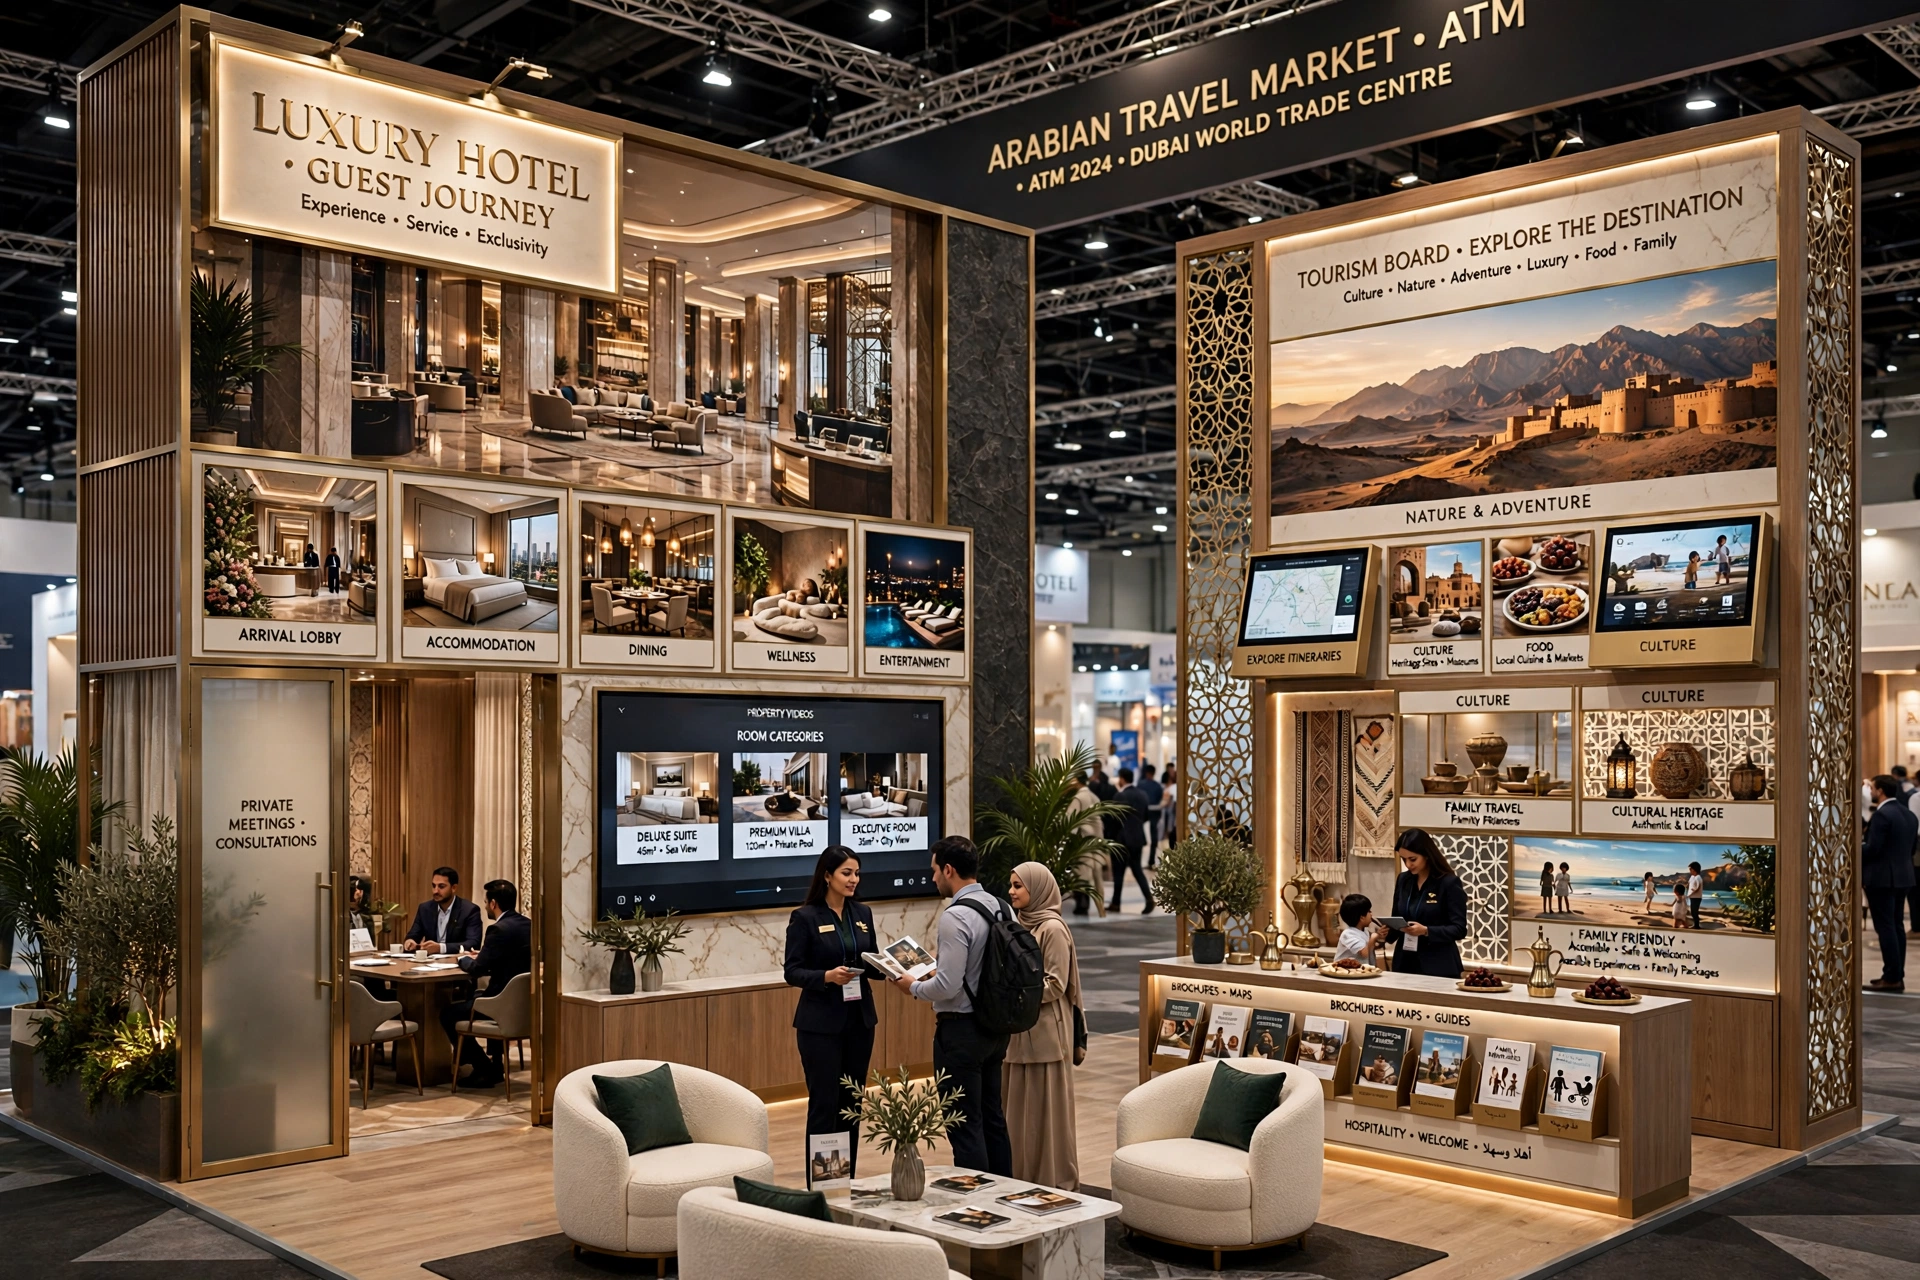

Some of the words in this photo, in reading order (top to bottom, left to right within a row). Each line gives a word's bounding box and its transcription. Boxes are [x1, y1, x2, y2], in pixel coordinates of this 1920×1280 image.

[988, 112, 1110, 173] ARABIAN
[1119, 78, 1238, 135] TRAVEL
[1251, 26, 1400, 100] MARKET
[1438, 0, 1525, 49] ATM
[1029, 167, 1064, 192] ATM
[1070, 154, 1112, 182] 2024
[1130, 133, 1189, 166] DUBAI
[1195, 113, 1271, 148] WORLD
[1277, 90, 1350, 126] TRADE
[1358, 62, 1452, 106] CENTRE
[252, 91, 439, 167] LUXURY
[457, 139, 590, 202] HOTEL
[307, 157, 411, 200] GUEST
[421, 181, 554, 229] JOURNEY
[301, 193, 386, 224] Experience
[406, 214, 459, 237] Service
[477, 228, 548, 259] Exclusivity
[1298, 257, 1378, 288] TOURISM
[1384, 244, 1449, 273] BOARD
[1470, 223, 1551, 257] EXPLORE
[1558, 215, 1596, 239] THE
[1603, 186, 1743, 232] DESTINATION
[1343, 288, 1383, 303] Culture
[1397, 278, 1436, 294] Nature
[1450, 264, 1511, 284] Adventure
[1527, 254, 1569, 271] Luxury
[1585, 241, 1616, 261] Food
[1634, 232, 1677, 252] Family
[1406, 506, 1466, 524] NATURE
[1473, 504, 1484, 518] &
[1490, 494, 1591, 516] ADVENTURE
[1036, 572, 1077, 592] OTEL
[238, 628, 296, 643] ARRIVAL
[300, 630, 342, 645] LOBBY
[426, 636, 535, 651] ACCOMMODATION
[628, 643, 667, 657] DINING
[1413, 645, 1453, 656] CULTURE
[1526, 641, 1554, 652] FOOD
[1640, 639, 1696, 652] CULTURE
[767, 650, 816, 663] WELLNESS
[1247, 653, 1285, 665] EXPLORE
[1288, 651, 1341, 663] ITINERARIES
[1496, 655, 1515, 664] Local
[1546, 653, 1552, 663] &
[1456, 694, 1510, 707] CULTURE
[1642, 690, 1704, 703] CULTURE
[786, 708, 814, 719] VIDEOS
[737, 730, 767, 742] ROOM
[769, 731, 824, 742] CATEGORIES
[241, 799, 293, 812] PRIVATE
[1445, 801, 1481, 813] FAMILY
[1485, 802, 1523, 814] TRAVEL
[1612, 806, 1668, 818] CULTURAL
[1670, 807, 1723, 818] HERITAGE
[229, 817, 295, 831] MEETINGS
[789, 826, 811, 836] VILLA
[1674, 820, 1682, 830] &
[1684, 820, 1708, 830] Local
[216, 835, 317, 849] CONSULTATIONS
[674, 830, 697, 841] SUITE
[1579, 929, 1618, 942] FAMILY
[1622, 932, 1675, 946] FRIENDLY
[1229, 988, 1253, 1000] MAPS
[1330, 1000, 1385, 1016] BROCHURES
[1396, 1008, 1422, 1021] MAPS
[1434, 1013, 1471, 1026] GUIDES
[1345, 1119, 1406, 1139] HOSPITALITY
[1418, 1131, 1469, 1150] WELCOME
